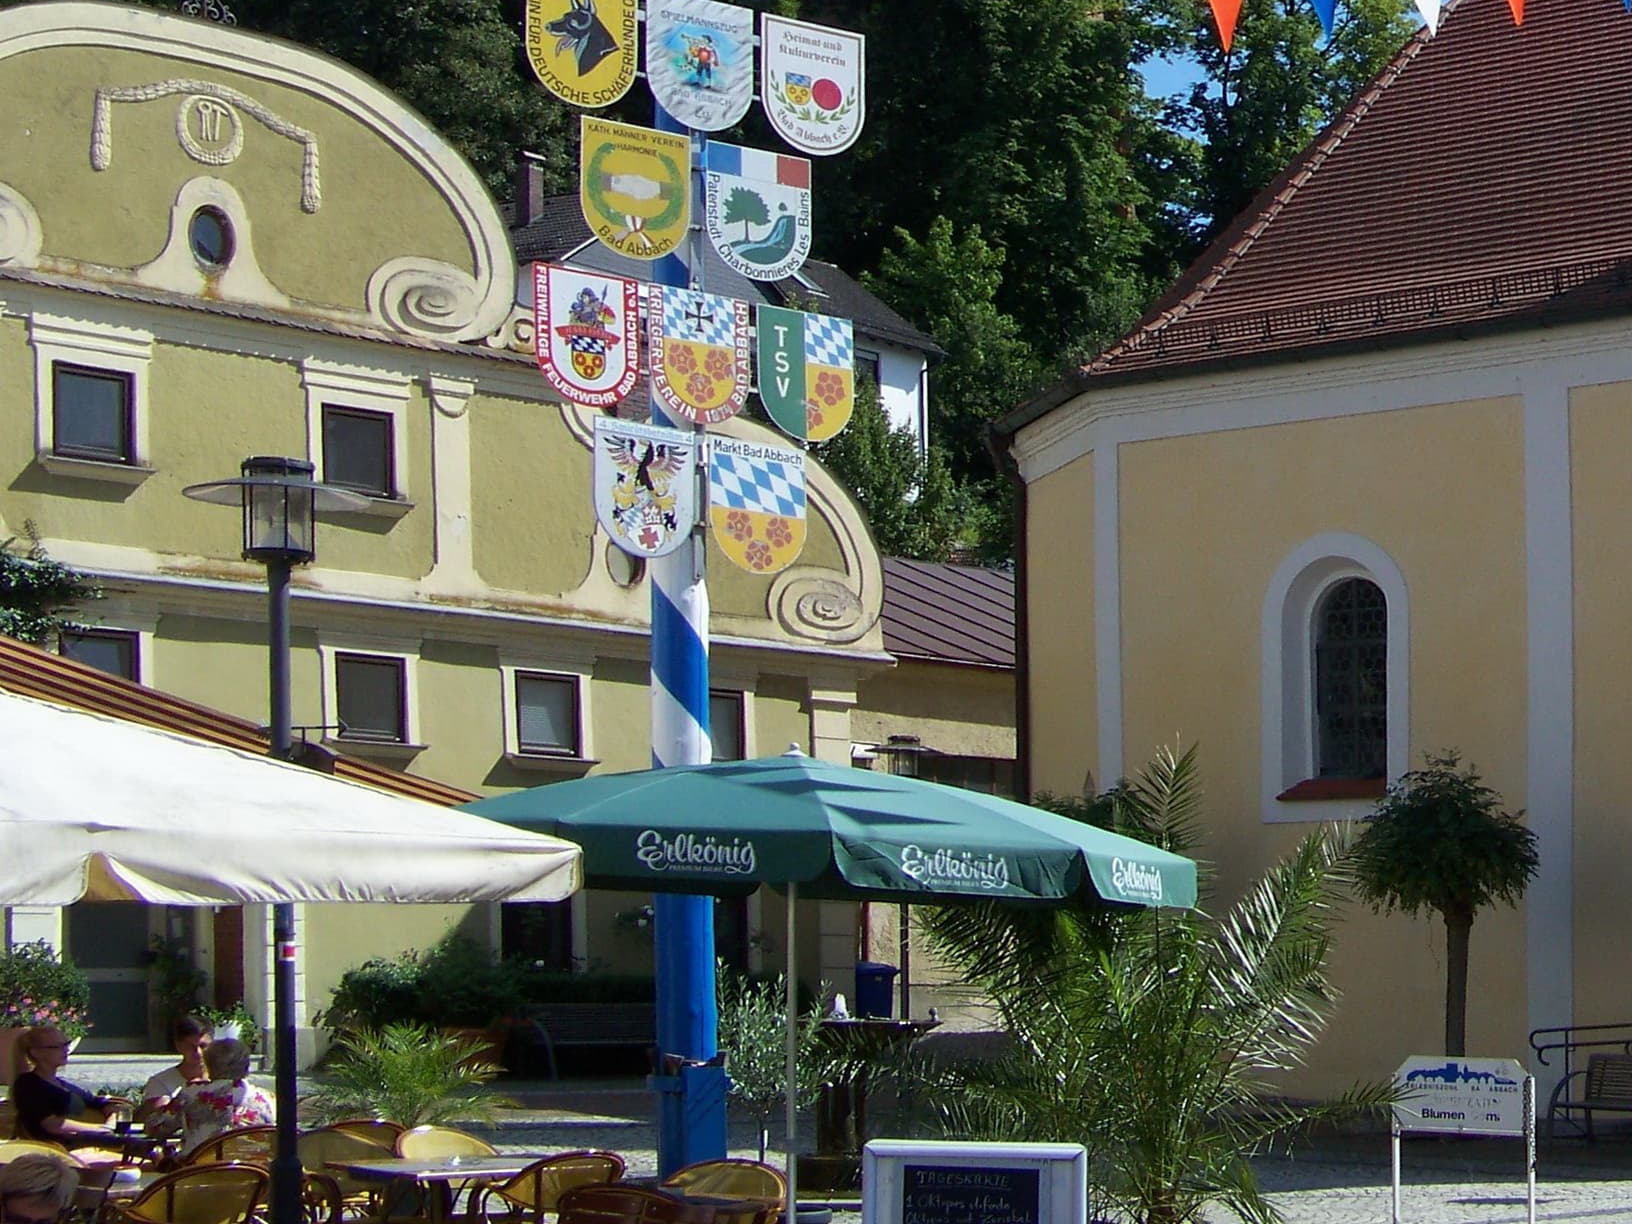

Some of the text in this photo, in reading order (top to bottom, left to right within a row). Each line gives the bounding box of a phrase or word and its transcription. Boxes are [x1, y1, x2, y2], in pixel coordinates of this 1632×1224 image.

[528, 47, 591, 105] DEUTSCHE
[708, 172, 722, 240] Patenstadt
[797, 190, 810, 228] Bains
[598, 224, 674, 257] Bad Abbach
[794, 233, 810, 257] Les
[535, 264, 550, 359] FREIWILLIGE
[625, 310, 639, 371] ABBACH
[735, 301, 749, 371] ABBACH
[541, 361, 619, 405] FEUERWEHR
[617, 370, 637, 397] BAD
[731, 372, 749, 406] BAD
[713, 438, 803, 466] Markt Bad Abbach
[637, 829, 755, 874] Erlkönig
[901, 844, 1008, 889] Erlkönig
[1112, 857, 1162, 900] Erlkönig
[1421, 1107, 1465, 1120] Blumen
